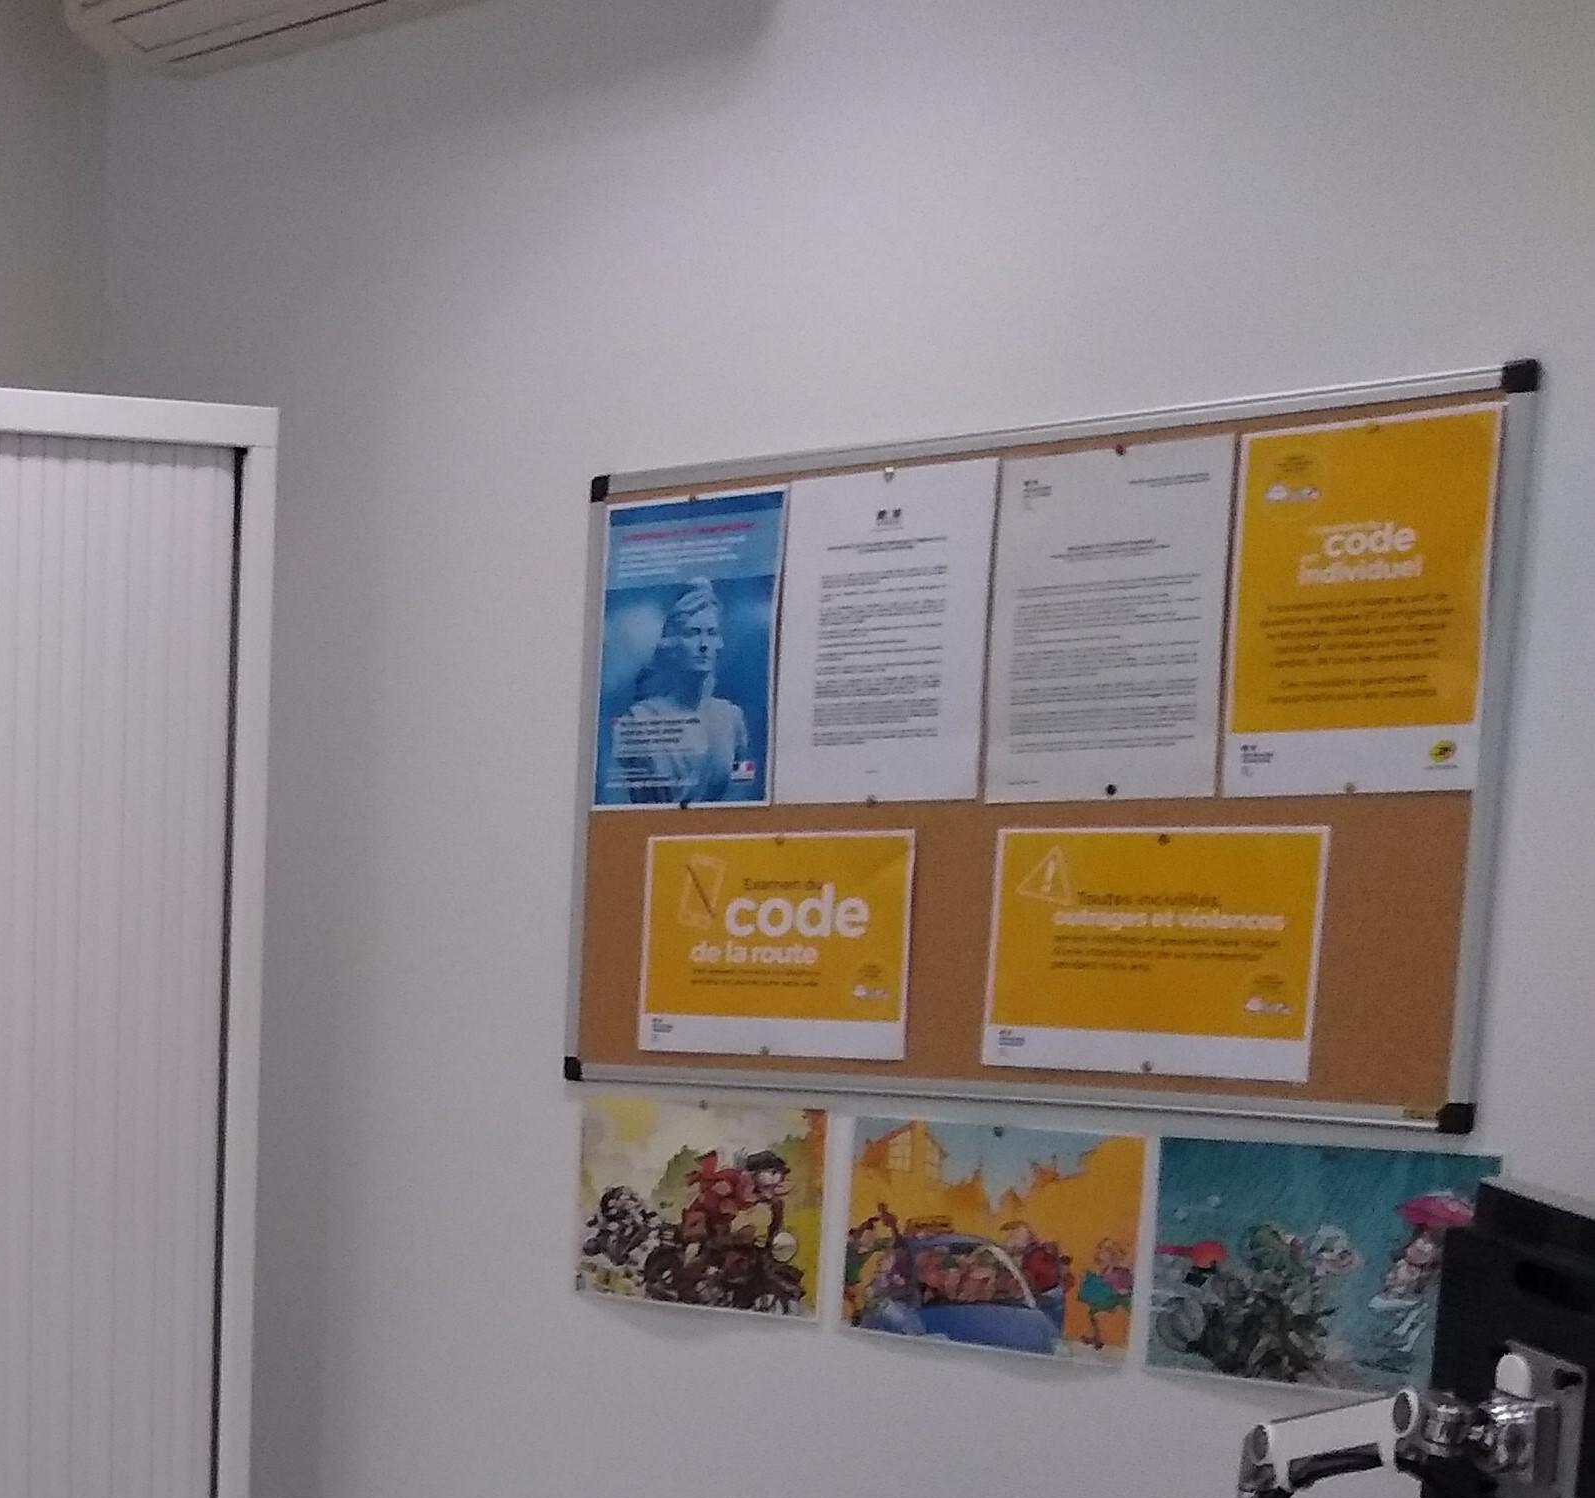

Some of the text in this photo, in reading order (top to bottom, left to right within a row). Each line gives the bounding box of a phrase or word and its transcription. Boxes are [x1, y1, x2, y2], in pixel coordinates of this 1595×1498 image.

[1324, 522, 1417, 556] code
[724, 881, 870, 938] code
[1054, 909, 1285, 930] outrages et violences
[689, 940, 819, 965] de la route
